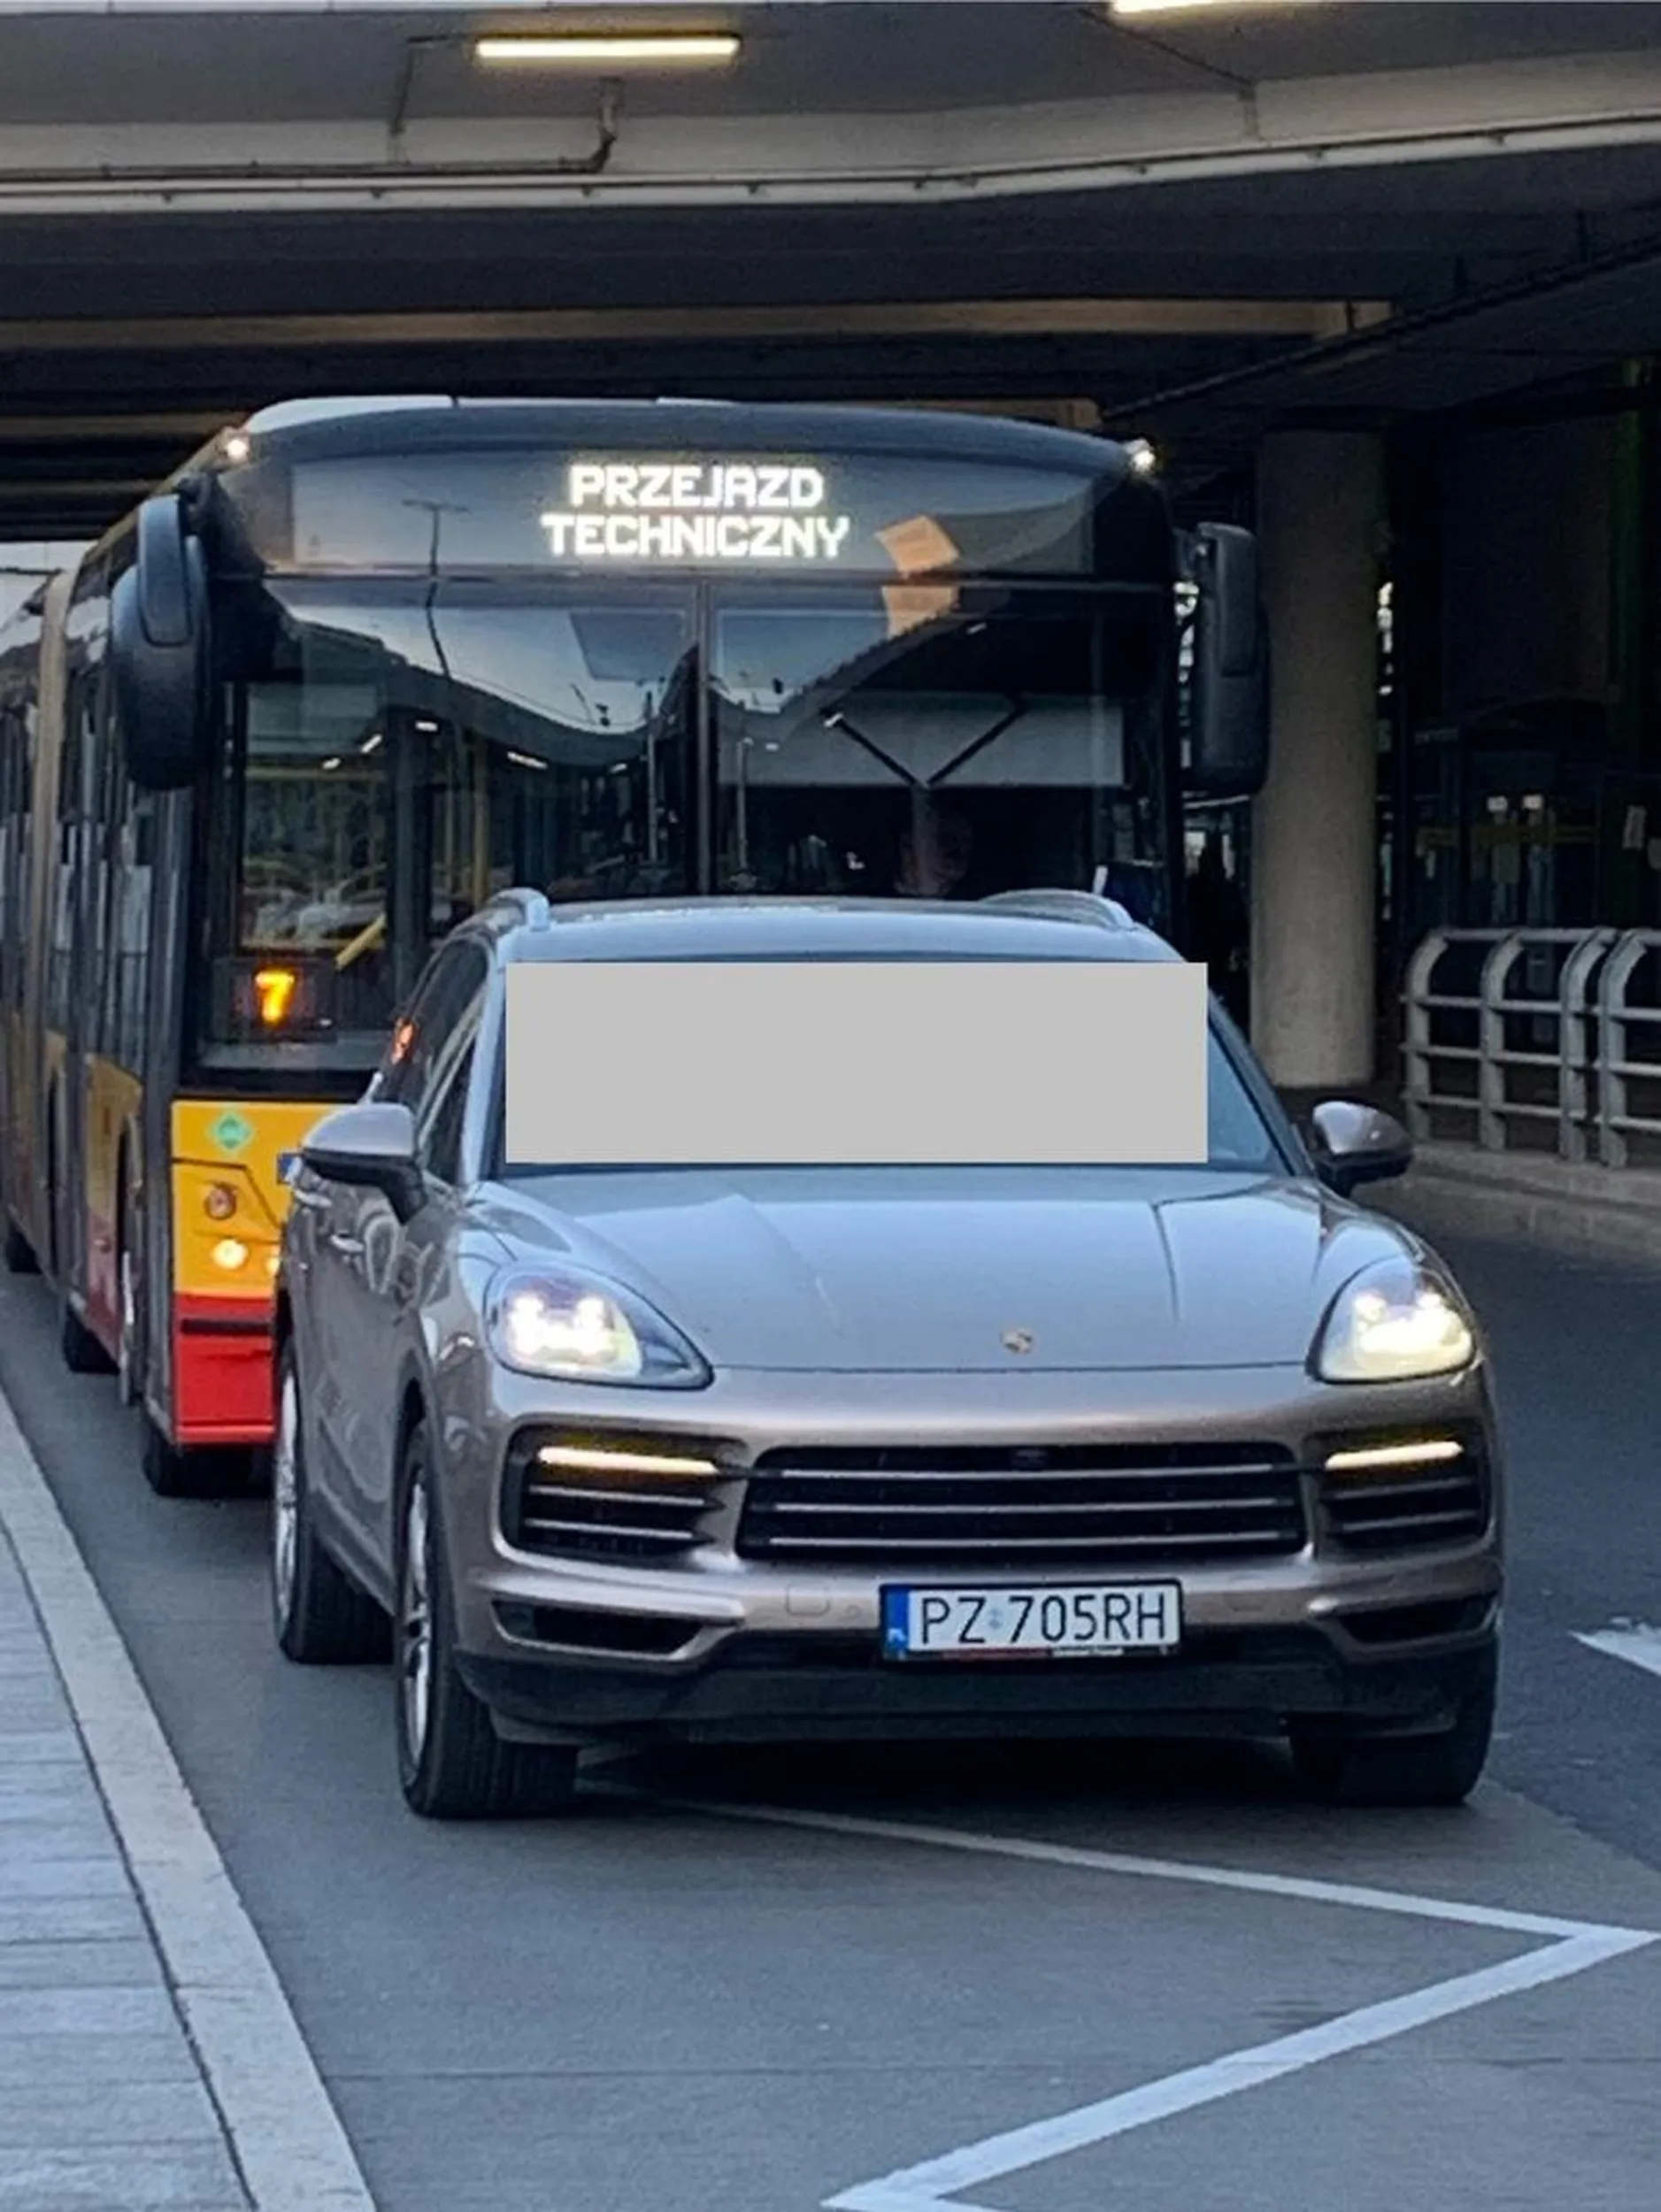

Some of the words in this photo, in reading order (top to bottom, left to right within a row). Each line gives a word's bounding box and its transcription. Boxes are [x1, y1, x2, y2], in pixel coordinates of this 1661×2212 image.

[568, 465, 824, 507] PRZEJAZD
[541, 514, 850, 558] TECHNICZNY
[254, 970, 296, 1024] 7
[921, 1596, 987, 1644] PZ
[1008, 1593, 1165, 1643] 705RH
